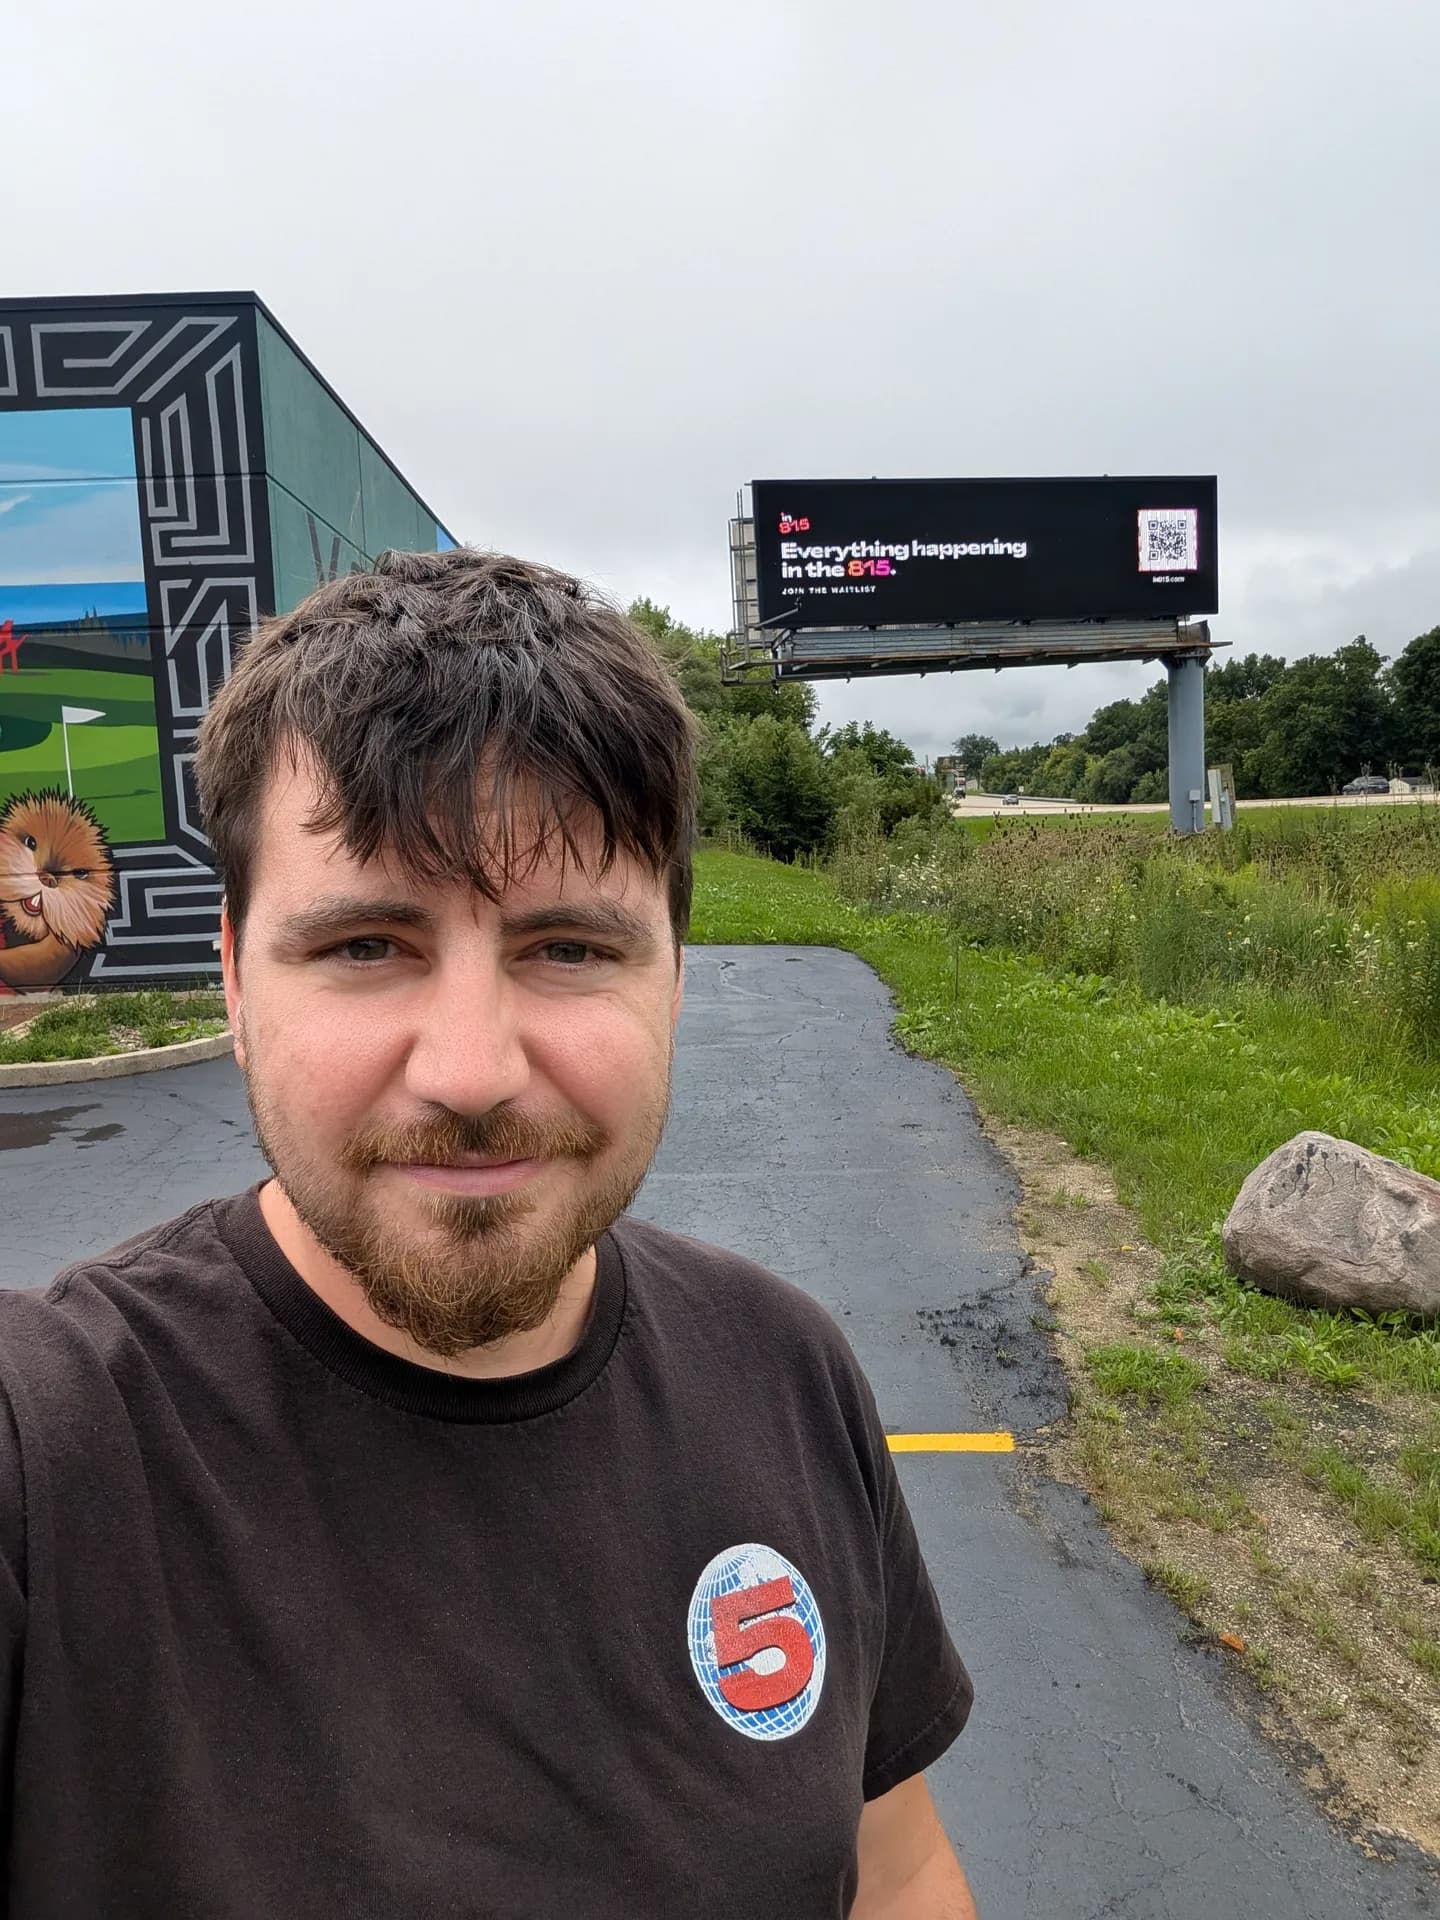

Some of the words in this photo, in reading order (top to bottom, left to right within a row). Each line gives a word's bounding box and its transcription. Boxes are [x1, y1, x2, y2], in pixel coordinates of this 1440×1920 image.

[779, 518, 810, 534] 815
[780, 512, 792, 522] in
[780, 539, 909, 562] Everything
[911, 537, 1027, 560] happening
[781, 561, 802, 579] in
[804, 561, 845, 578] the
[847, 559, 896, 577] 815.
[808, 586, 827, 594] THE
[831, 585, 876, 594] WAITLIST
[711, 1574, 815, 1714] 5
